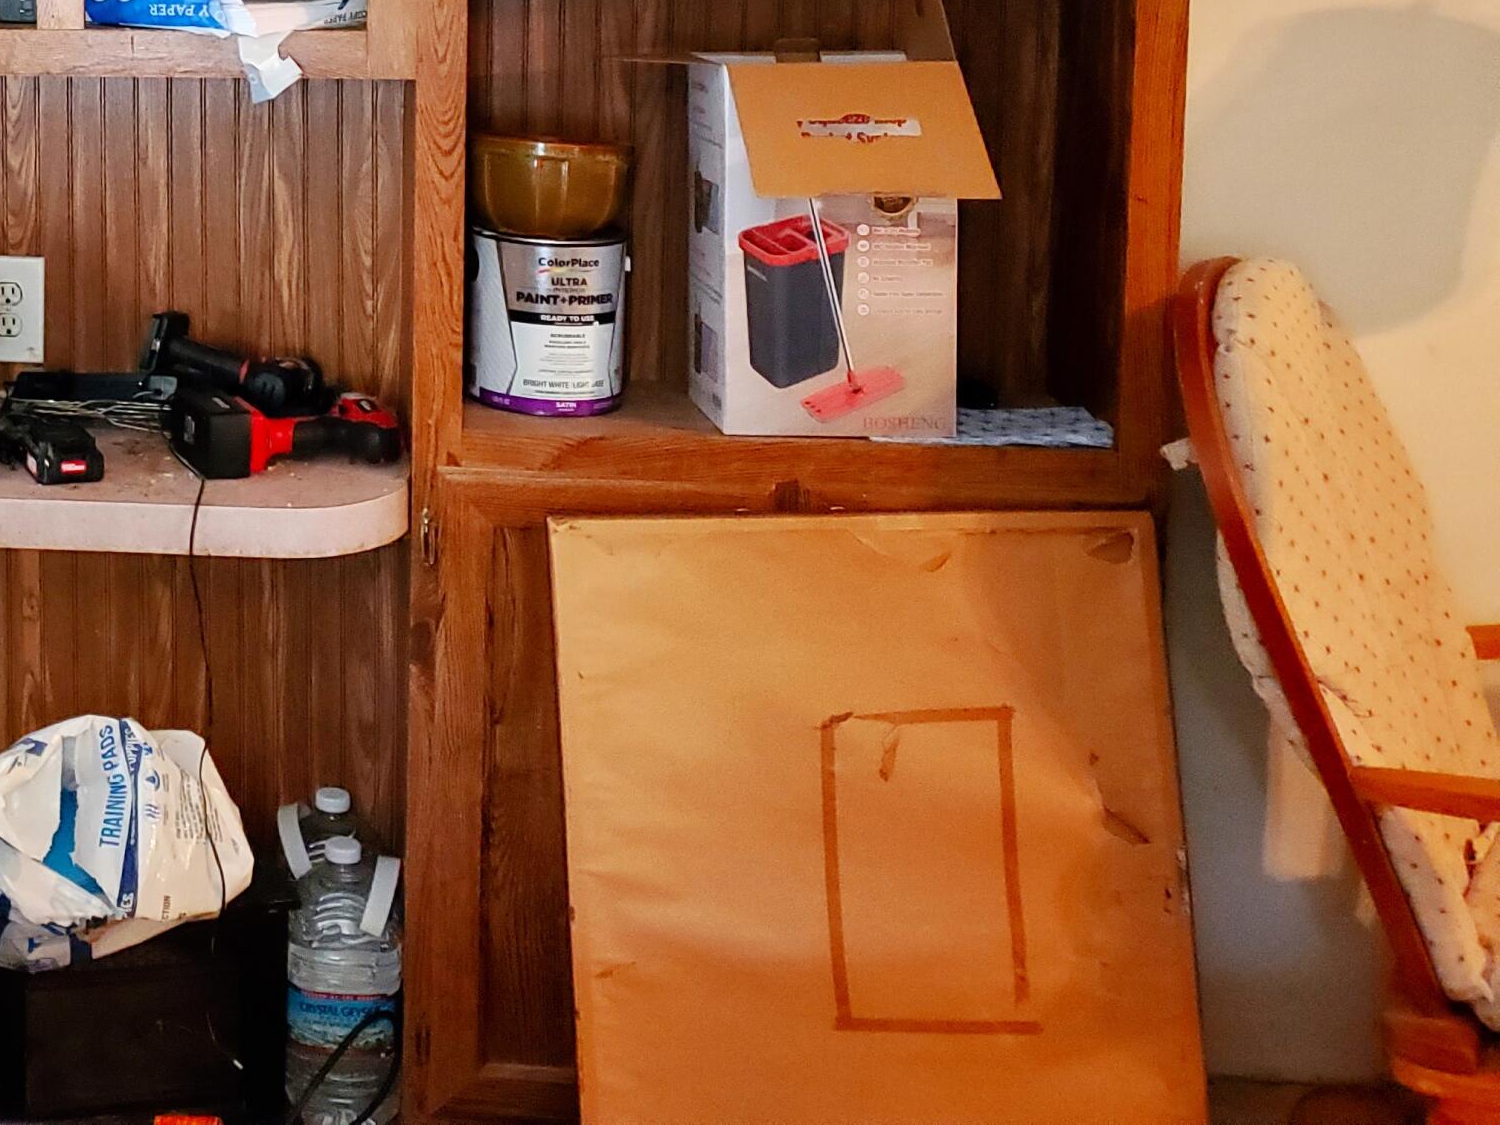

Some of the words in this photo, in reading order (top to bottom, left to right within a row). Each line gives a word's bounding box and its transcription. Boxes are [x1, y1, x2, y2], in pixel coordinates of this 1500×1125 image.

[149, 3, 195, 17] PAPER
[538, 257, 600, 268] ColorPlace
[551, 277, 588, 287] ULTRA
[540, 314, 567, 322] READY
[523, 378, 548, 388] BRIGHT
[548, 380, 570, 389] WHITE
[555, 401, 577, 409] SATIN
[99, 725, 121, 771] PADS
[99, 774, 128, 849] TRAINING
